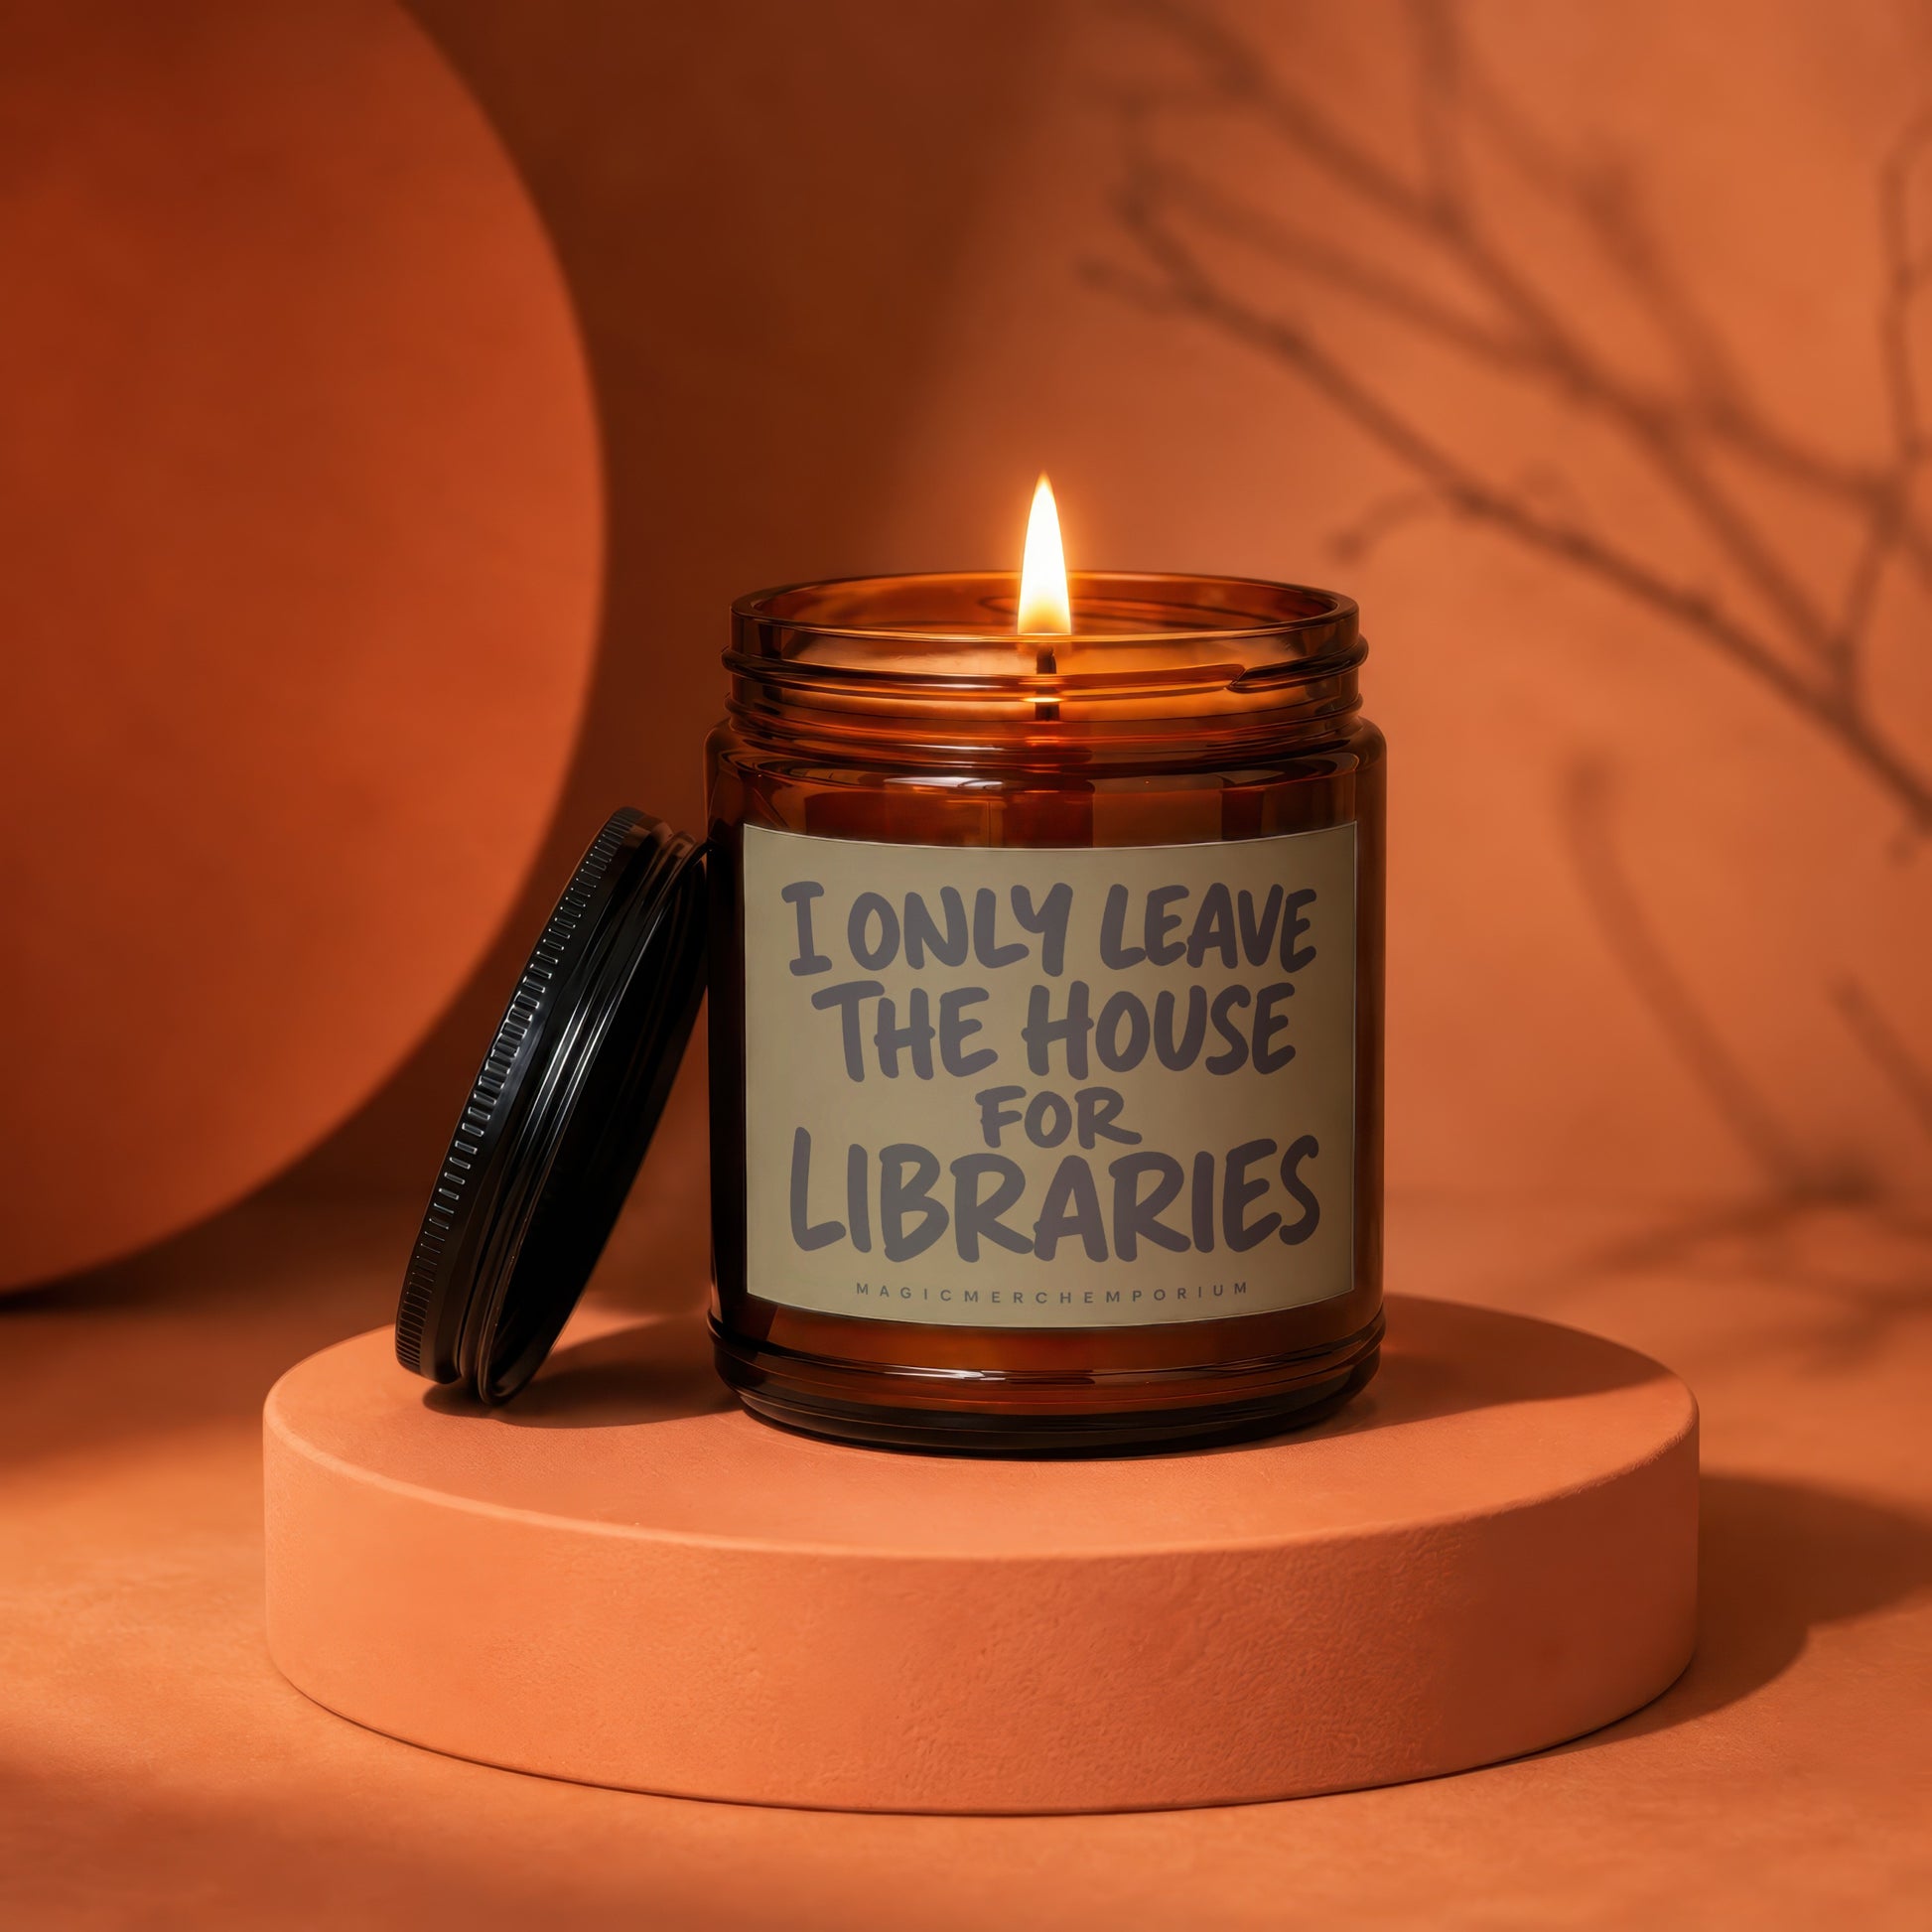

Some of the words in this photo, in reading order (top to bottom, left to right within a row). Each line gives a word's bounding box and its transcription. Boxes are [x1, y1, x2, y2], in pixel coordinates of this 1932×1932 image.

[781, 881, 832, 977] I
[847, 883, 1073, 977] ONLY
[1100, 883, 1317, 973] LEAVE
[811, 981, 998, 1082] THE
[1022, 980, 1297, 1080] HOUSE
[975, 1085, 1143, 1150] FOR
[789, 1126, 1320, 1263] LIBRARIES
[856, 1282, 1248, 1305] MAGICMERCHEMPORIUM
